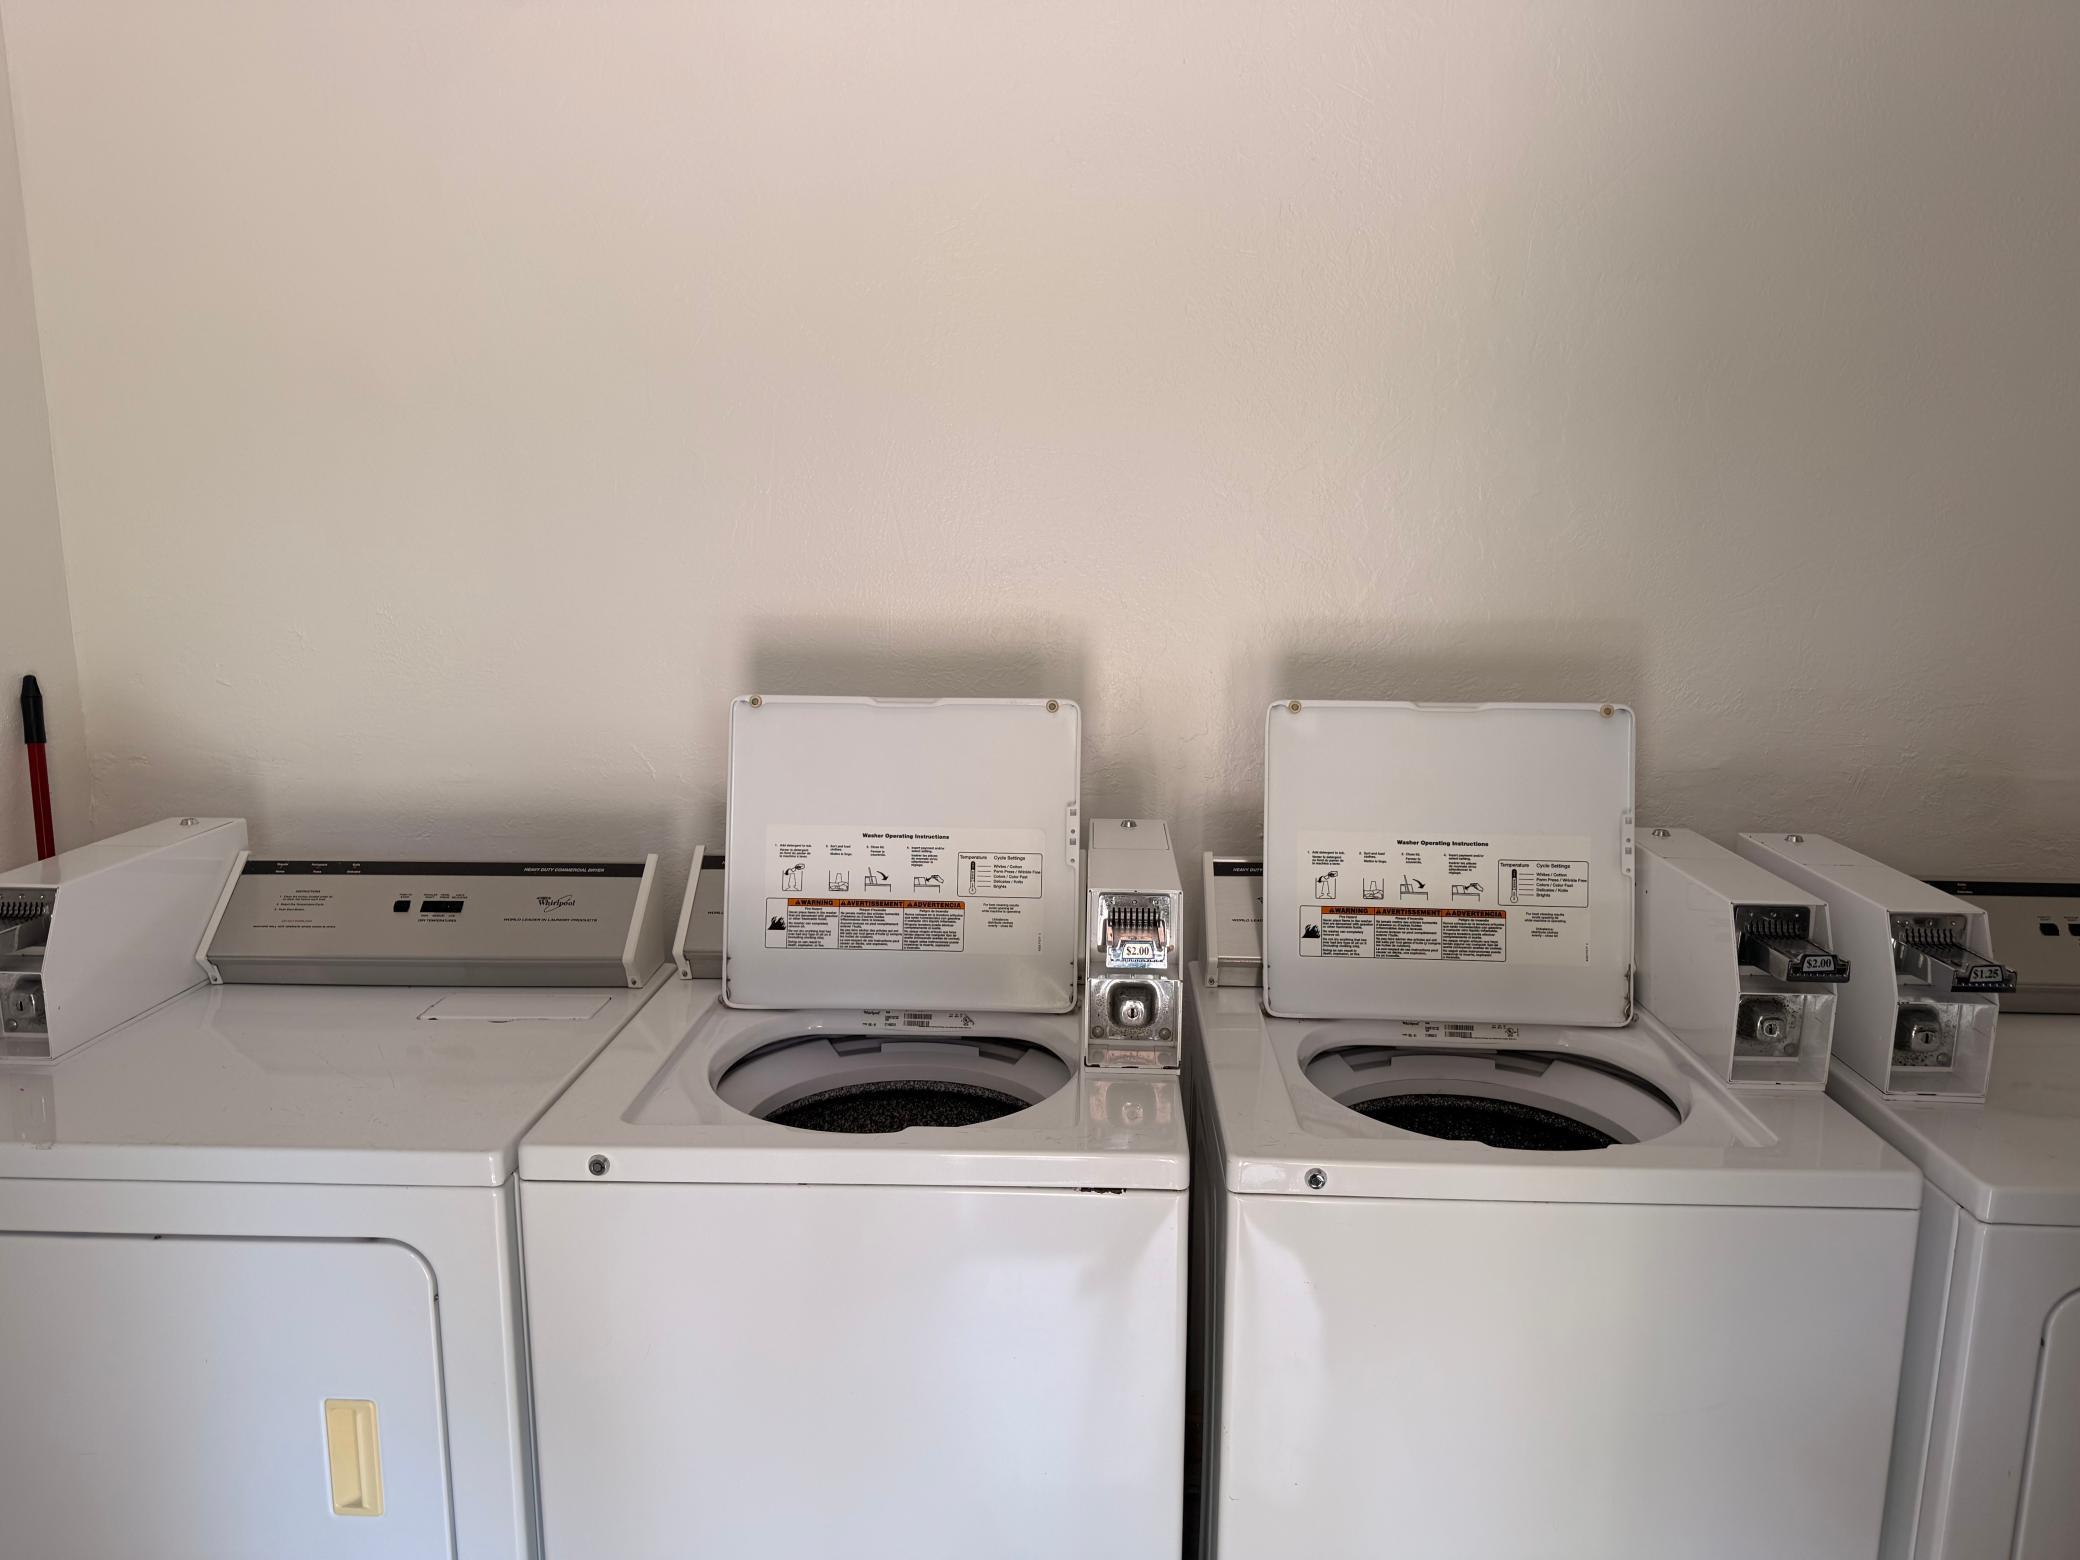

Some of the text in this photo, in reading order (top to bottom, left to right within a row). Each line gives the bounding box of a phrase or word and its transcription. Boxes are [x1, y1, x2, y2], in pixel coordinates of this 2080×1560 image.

[538, 899, 576, 907] Whirlpool
[1126, 946, 1150, 956] $2.00
[1806, 958, 1831, 968] $2.00
[1972, 969, 1999, 979] $1.25
